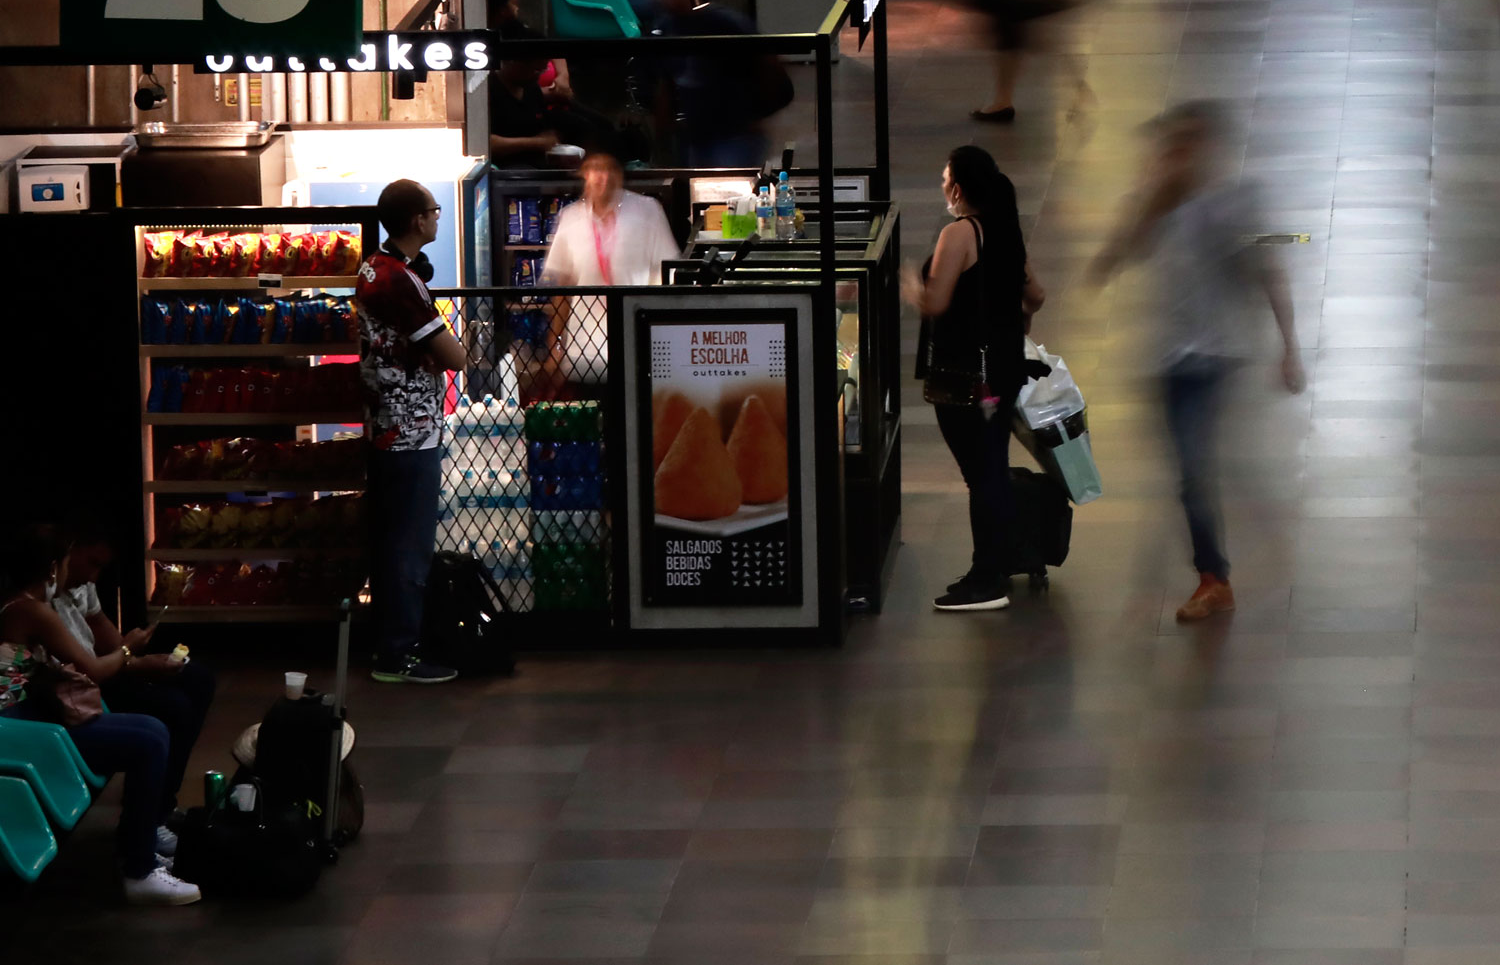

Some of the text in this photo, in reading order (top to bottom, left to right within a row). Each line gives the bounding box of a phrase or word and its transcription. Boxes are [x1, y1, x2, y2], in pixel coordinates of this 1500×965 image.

[691, 331, 747, 346] A MELHOR
[690, 348, 750, 364] ESCOLHA
[693, 368, 748, 377] outtakes
[665, 539, 723, 555] SALGADOS
[665, 555, 712, 571] BEBIDAS
[666, 571, 702, 587] DOCES
